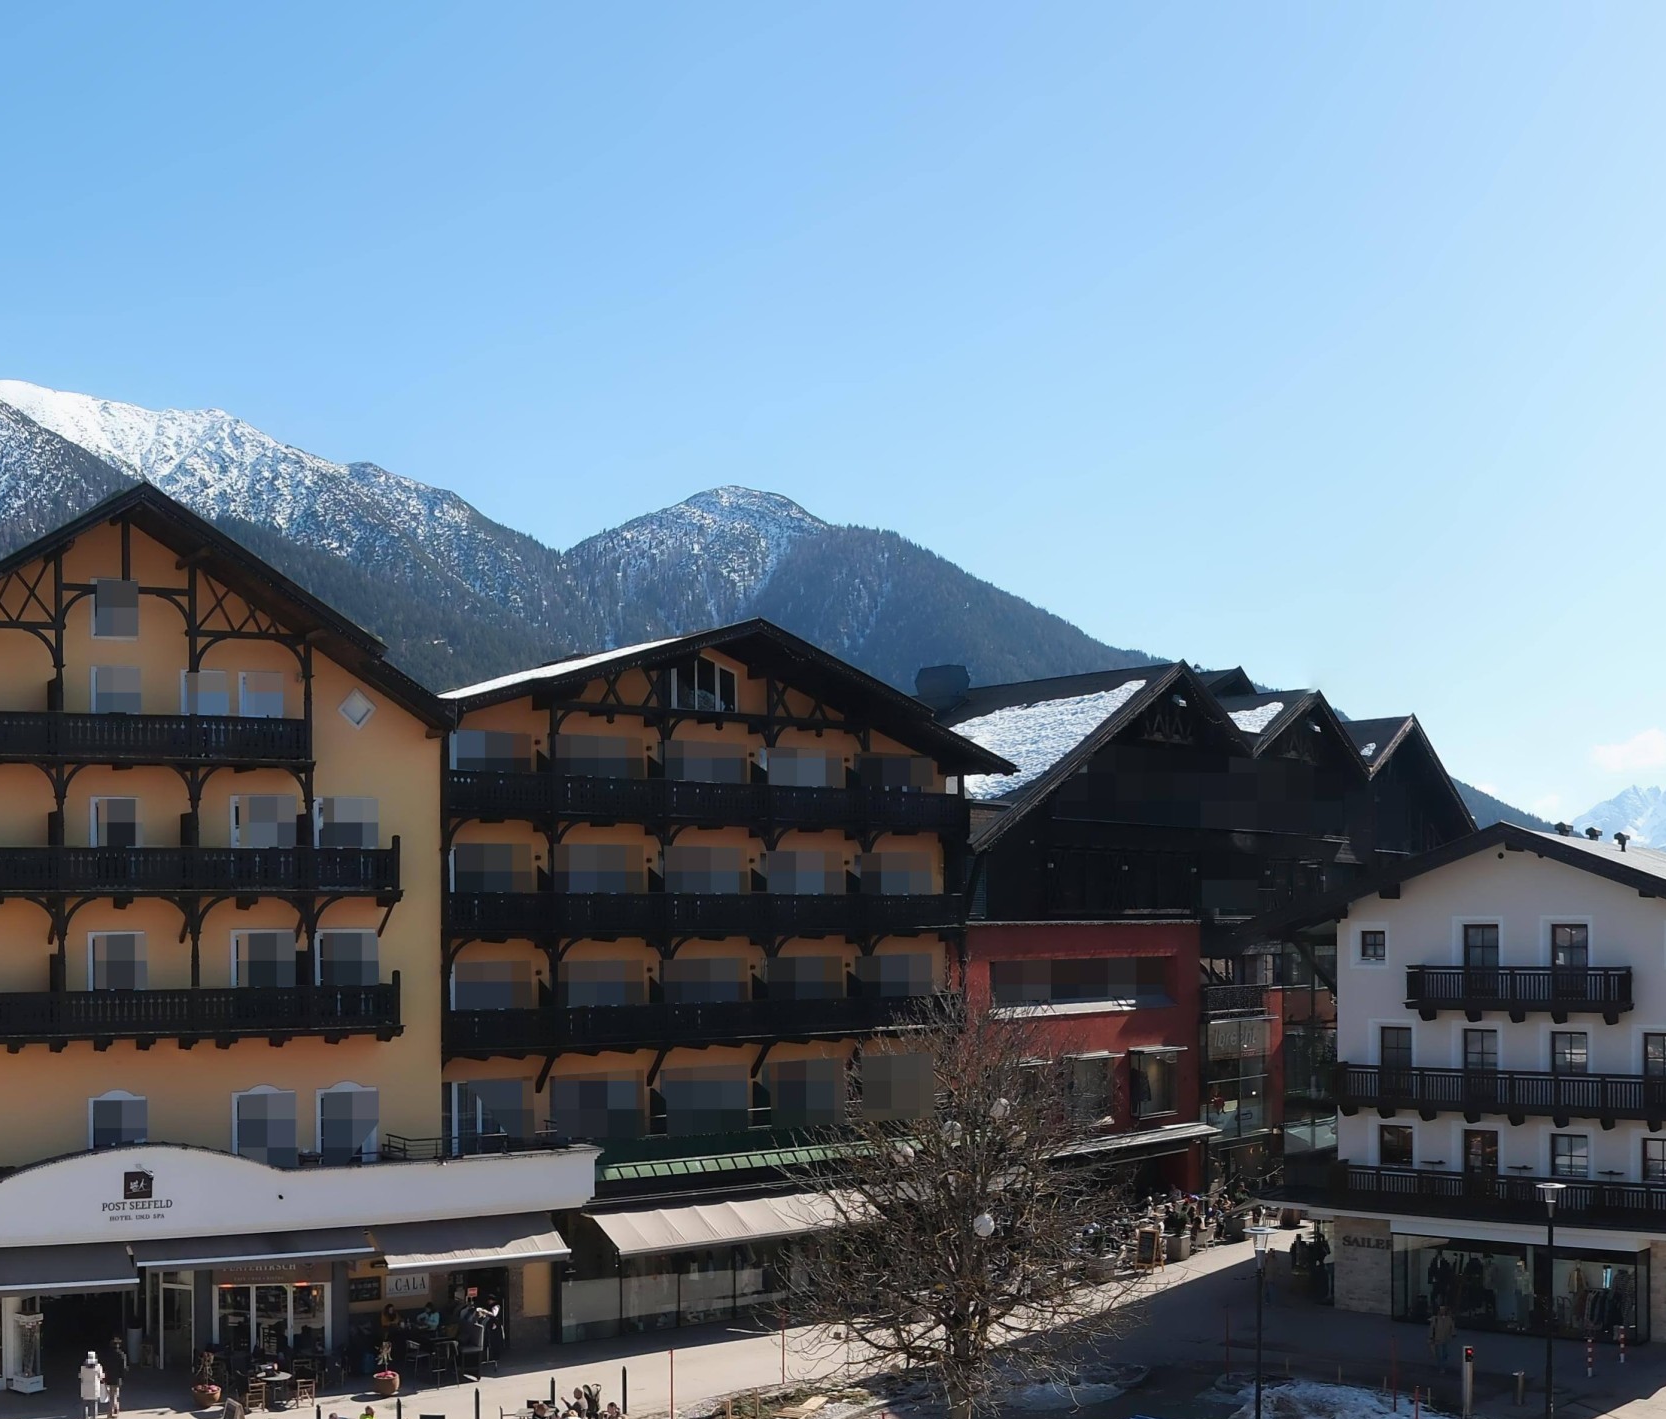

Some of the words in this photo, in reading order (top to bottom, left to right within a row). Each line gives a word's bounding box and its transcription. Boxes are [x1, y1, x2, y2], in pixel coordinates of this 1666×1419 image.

[102, 1201, 127, 1212] POST
[129, 1199, 173, 1210] SEEFELD
[395, 1275, 426, 1292] CALA
